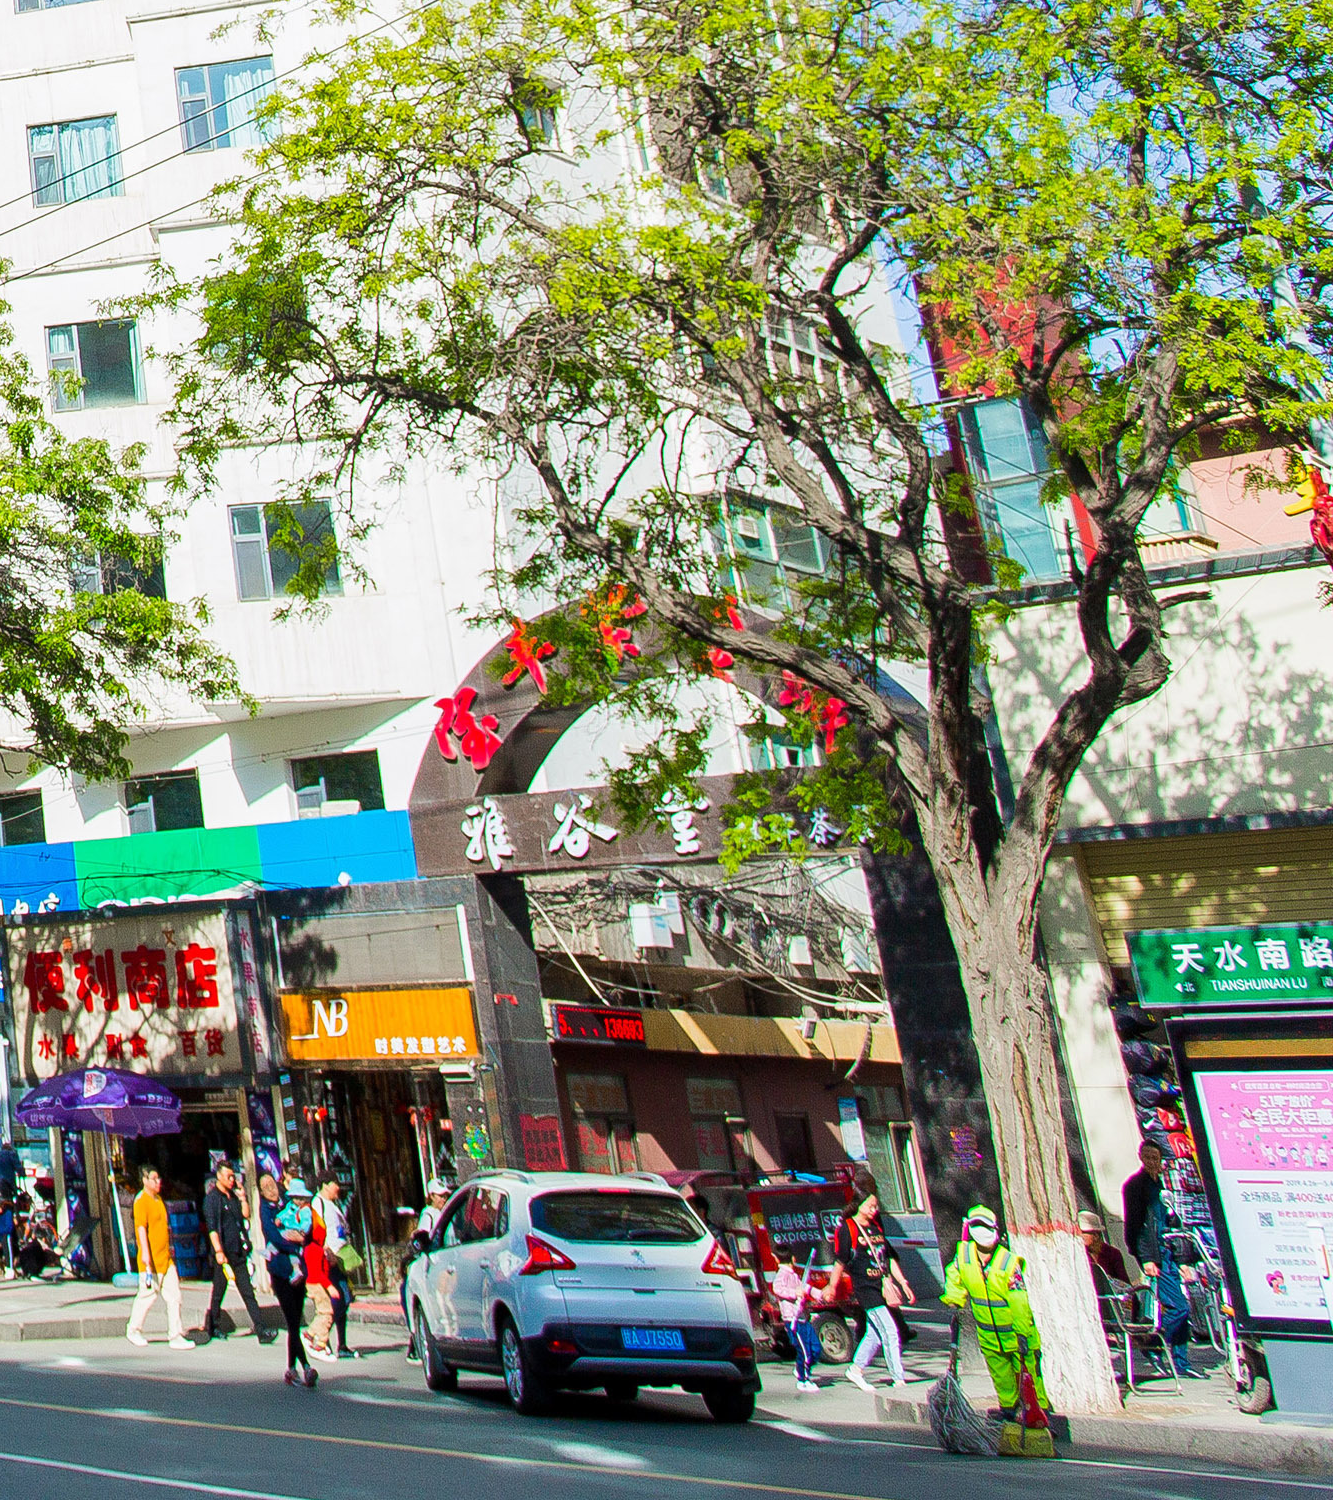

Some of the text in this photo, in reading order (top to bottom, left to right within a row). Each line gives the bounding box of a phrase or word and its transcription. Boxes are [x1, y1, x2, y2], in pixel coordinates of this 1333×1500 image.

[1170, 935, 1333, 975] 天水南路
[23, 942, 220, 1014] 便利商店
[1209, 976, 1309, 992] TIANSHUINAN LU
[291, 999, 349, 1040] NB
[38, 1028, 226, 1060] 水果 副食 百货
[768, 1212, 819, 1231] 申通快递
[773, 1230, 822, 1245] express
